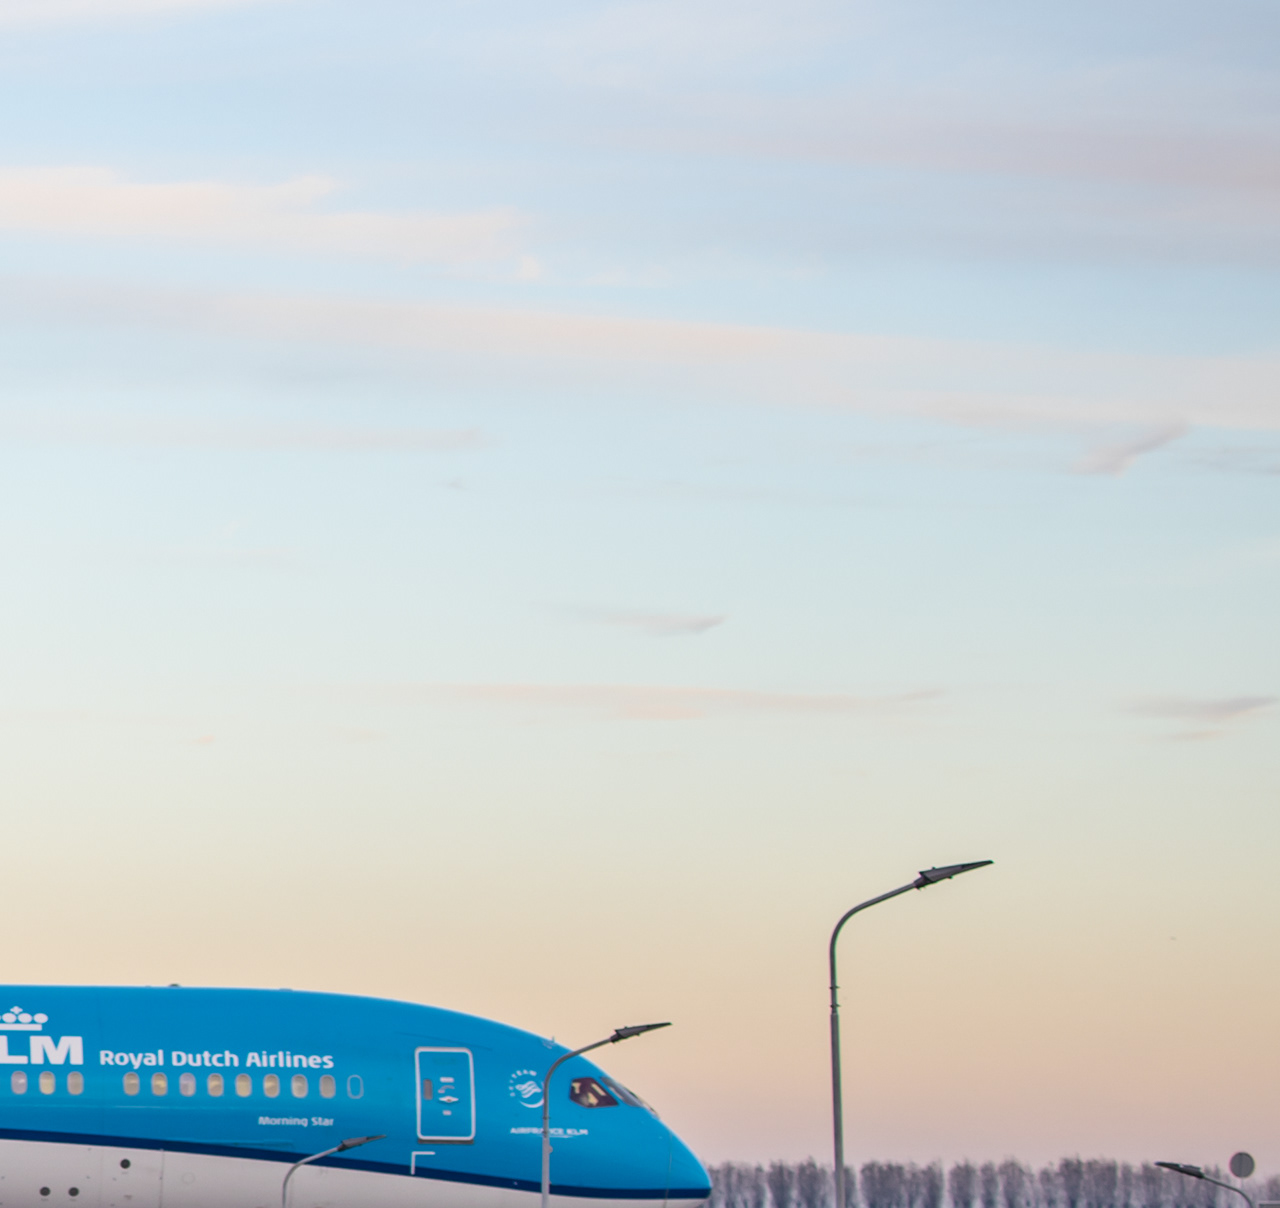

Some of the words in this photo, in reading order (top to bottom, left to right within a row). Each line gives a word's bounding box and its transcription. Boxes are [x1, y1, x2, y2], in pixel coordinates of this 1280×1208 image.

[99, 1049, 164, 1069] Royal
[171, 1051, 239, 1067] Dutch
[245, 1051, 334, 1069] Airlines
[258, 1116, 308, 1127] Morning
[311, 1117, 334, 1126] Star
